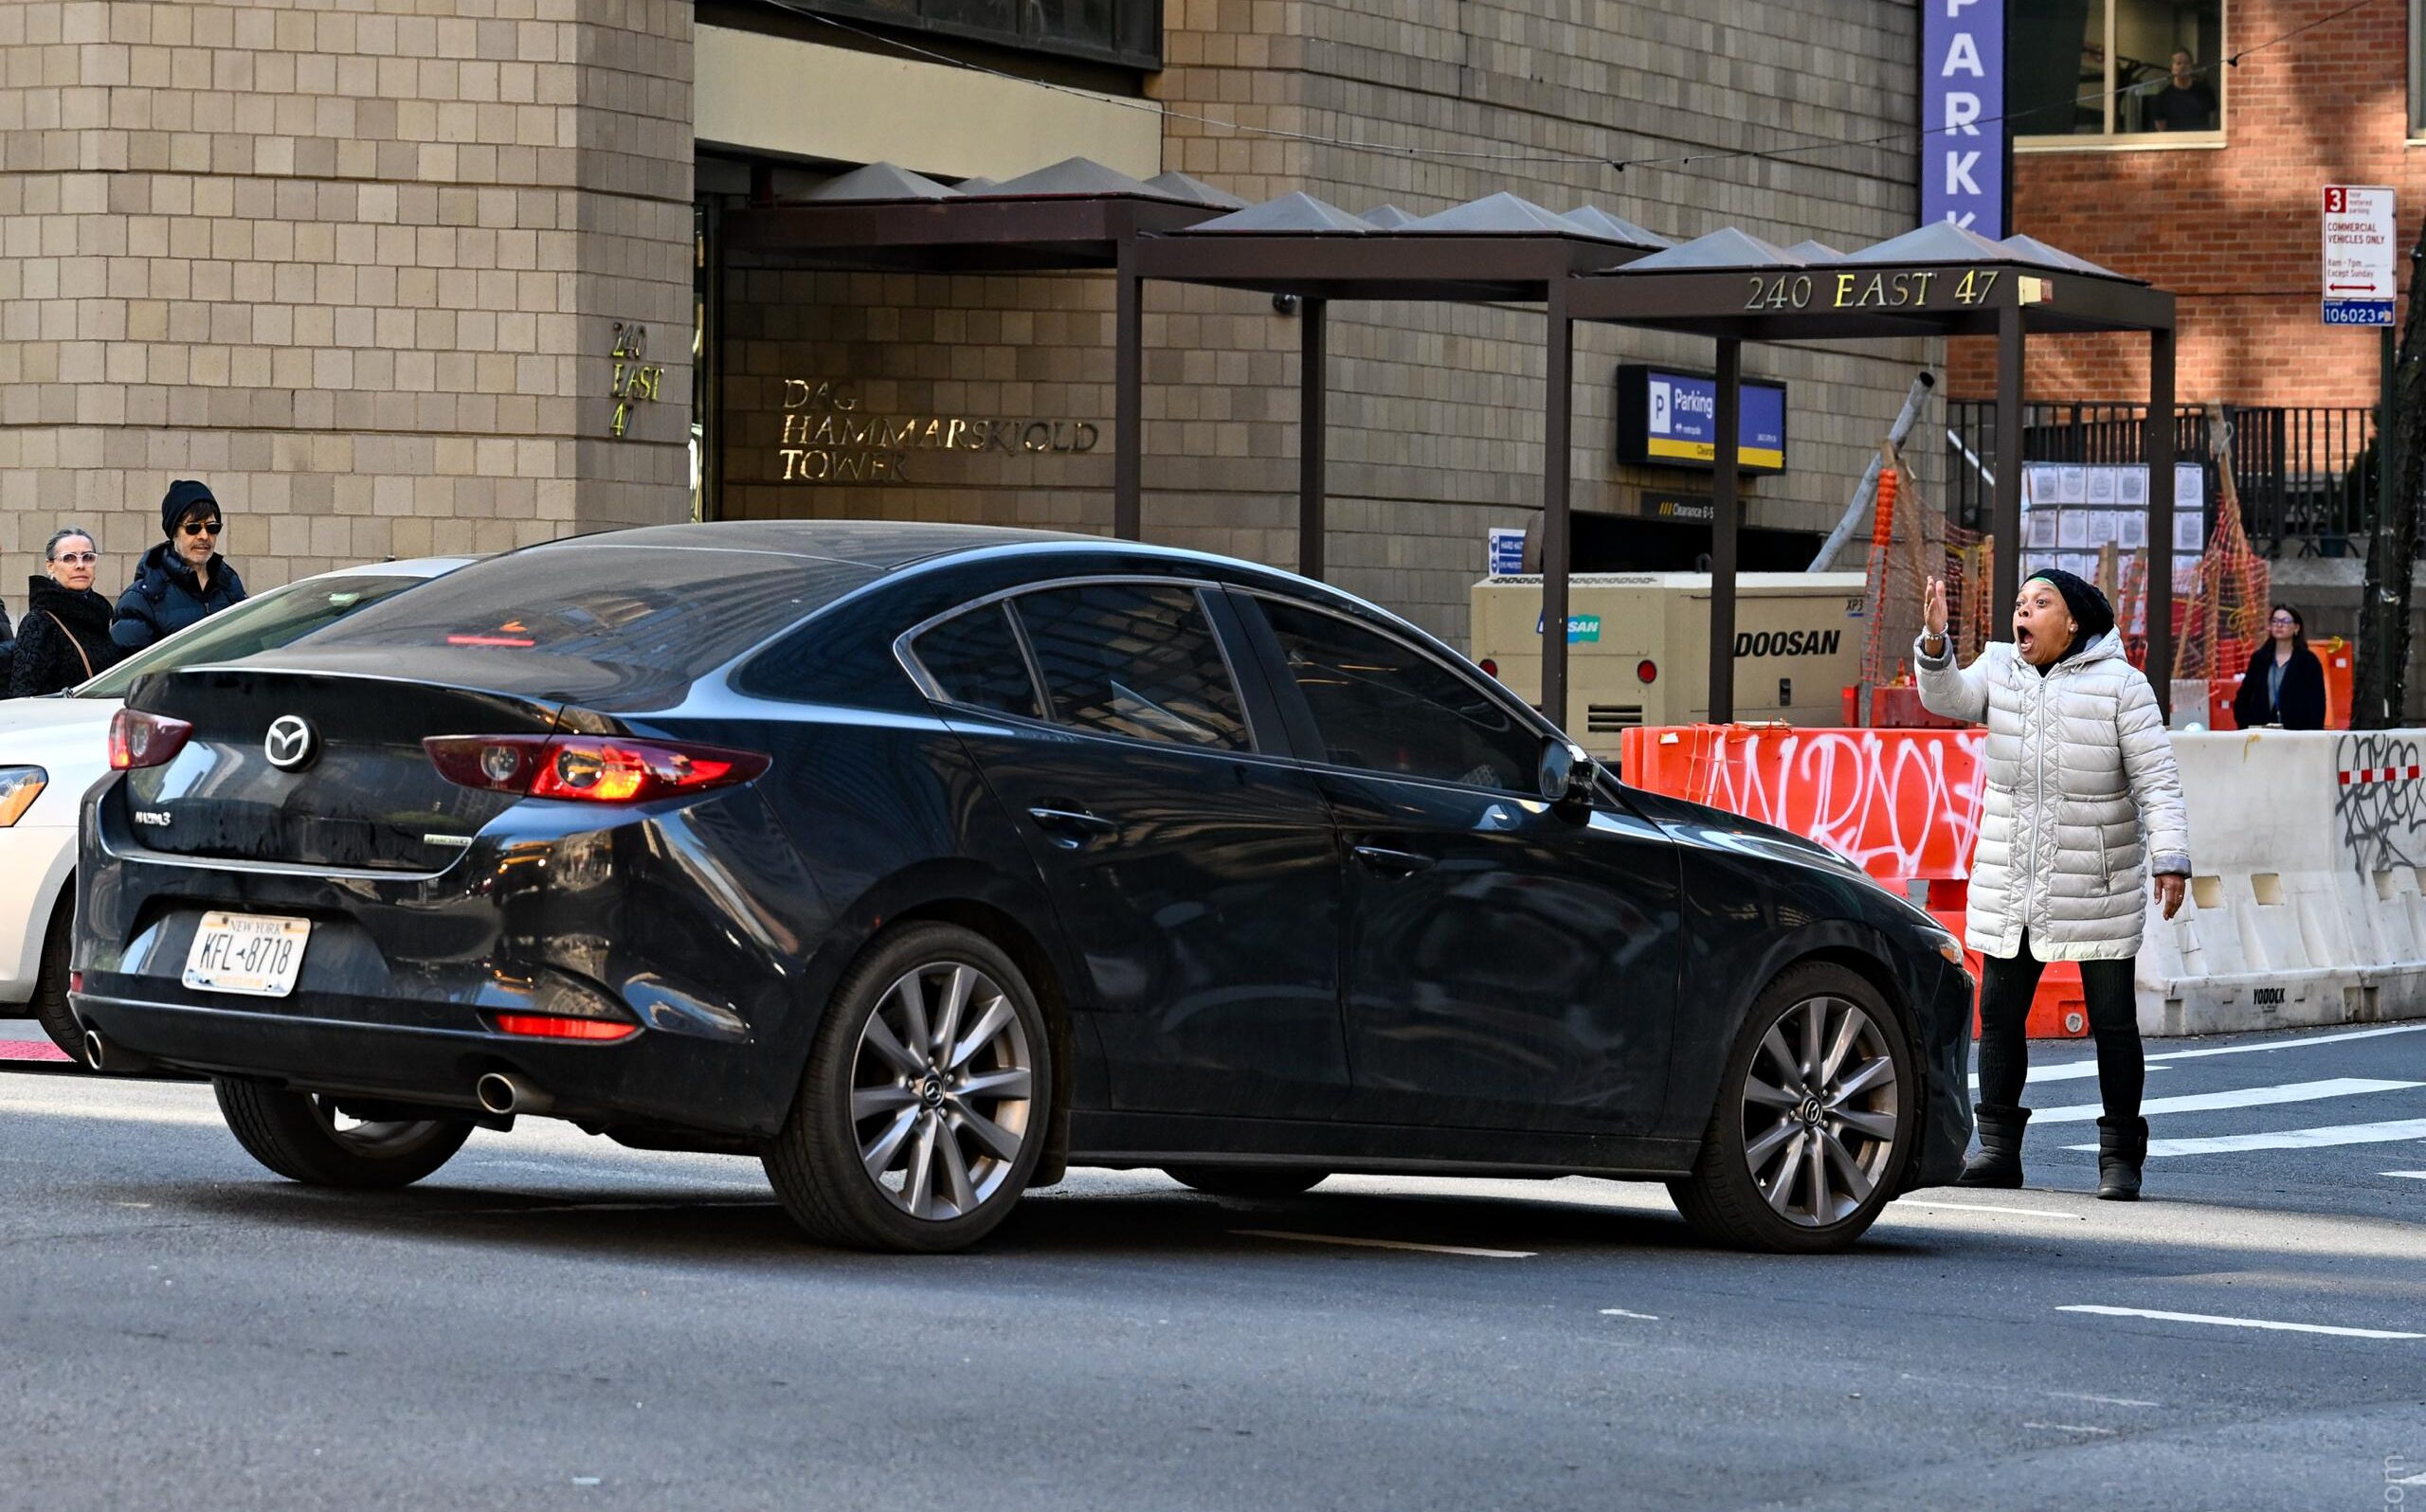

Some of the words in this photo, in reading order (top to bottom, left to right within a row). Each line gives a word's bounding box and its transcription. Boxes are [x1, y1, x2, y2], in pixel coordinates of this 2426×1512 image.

[2330, 189, 2342, 211] 3
[2327, 223, 2377, 232] COMMERCIAL
[2327, 234, 2363, 244] VEHICLES
[2365, 235, 2385, 244] ONLY
[1745, 275, 1812, 310] 240
[1834, 272, 1937, 307] EAST
[1954, 269, 1999, 305] 47
[2326, 308, 2376, 322] 106023
[611, 322, 646, 357] 240
[611, 363, 664, 401] EAST
[783, 379, 857, 410] DAG
[1656, 394, 1666, 420] P
[1675, 387, 1713, 419] Parking
[610, 403, 634, 437] 47
[780, 449, 909, 481] TOWER
[1673, 503, 1702, 518] Clearance
[1734, 630, 1840, 657] DOOSAN
[228, 920, 251, 933] NEW
[255, 922, 281, 935] YORK
[2254, 988, 2285, 1004] YODOCK
